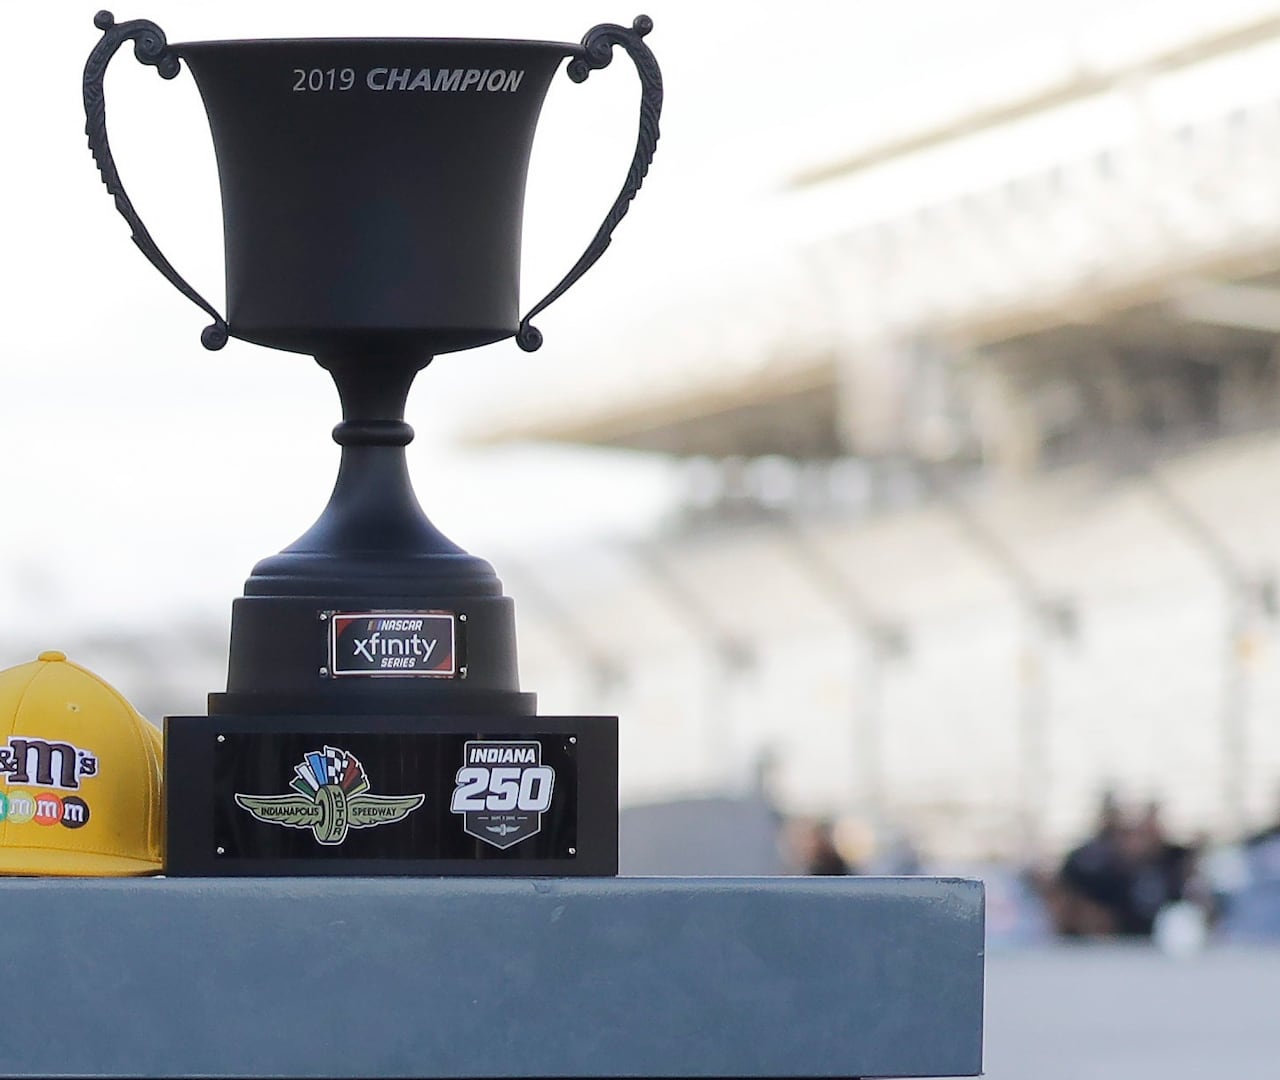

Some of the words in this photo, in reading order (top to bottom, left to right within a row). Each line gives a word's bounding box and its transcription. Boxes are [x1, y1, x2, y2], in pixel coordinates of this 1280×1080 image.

[293, 68, 355, 91] 2019
[366, 67, 525, 92] CHAMPION
[380, 620, 423, 631] NASCAR
[353, 632, 437, 662] xfinity
[380, 657, 416, 668] SERIES
[469, 748, 536, 763] INDIANA
[453, 767, 553, 811] 250
[261, 807, 319, 816] INDIANAPOLIS
[333, 791, 343, 836] MOTOR
[352, 807, 397, 816] SPEEDWAY
